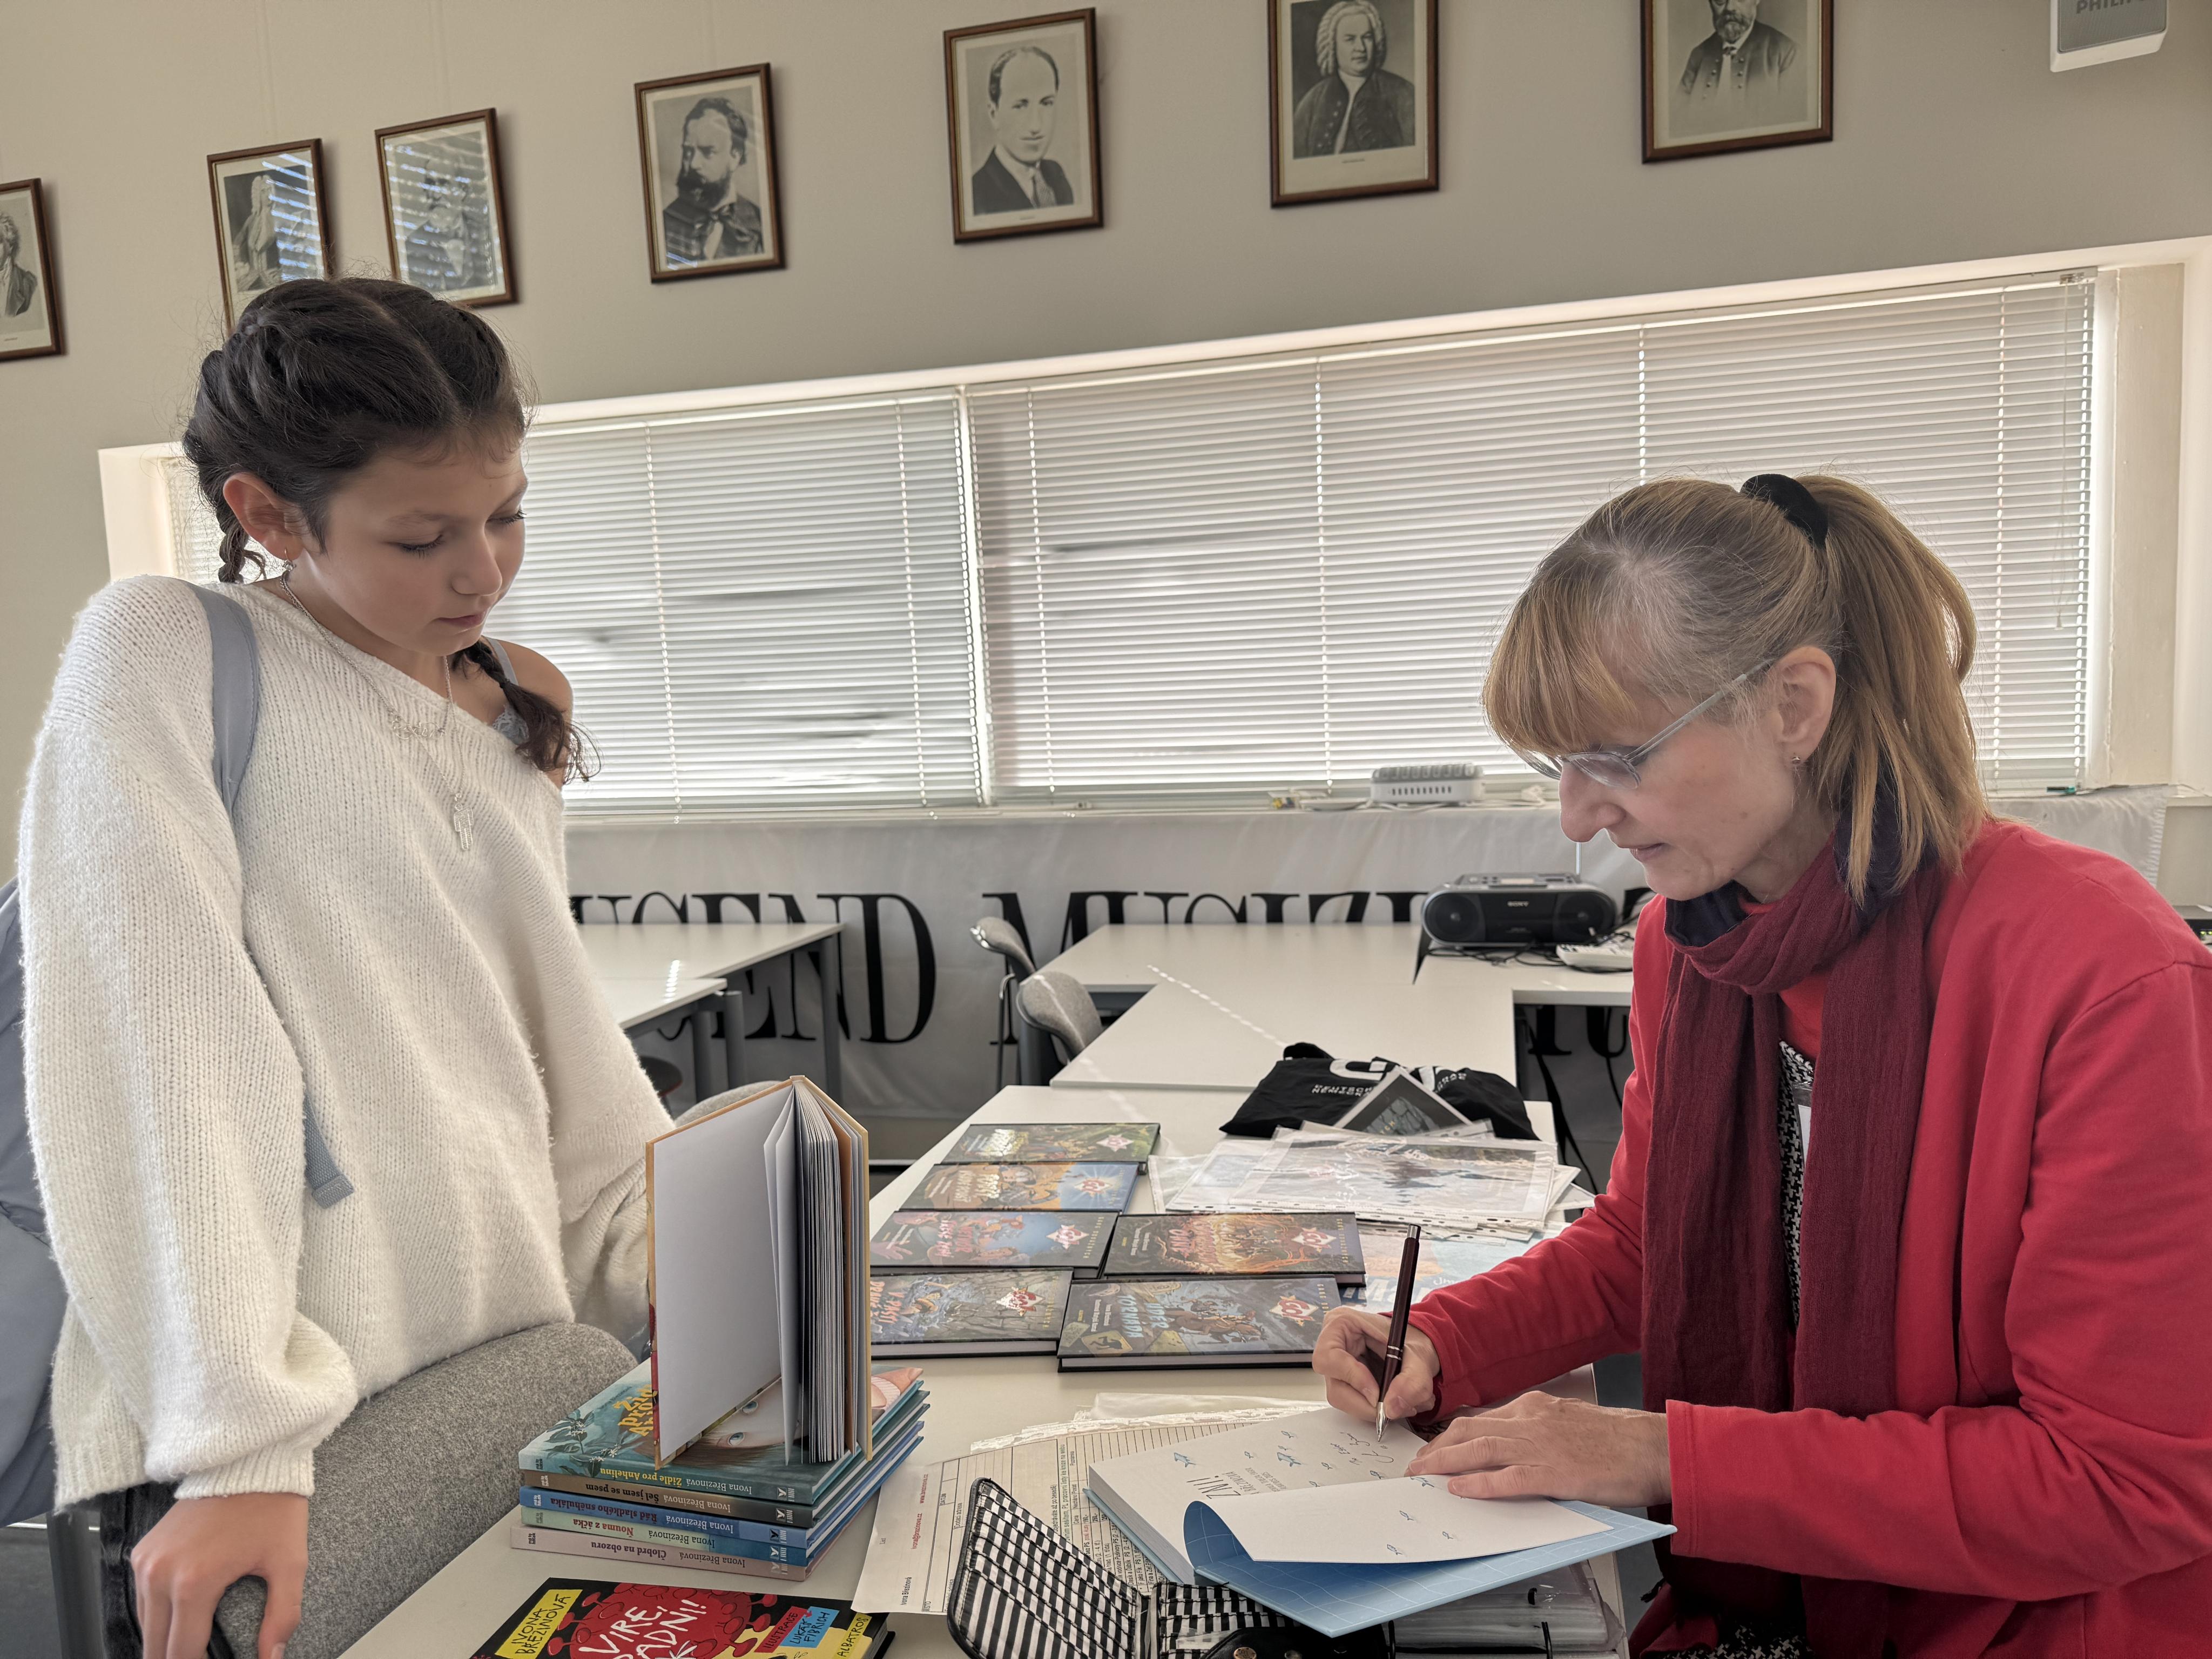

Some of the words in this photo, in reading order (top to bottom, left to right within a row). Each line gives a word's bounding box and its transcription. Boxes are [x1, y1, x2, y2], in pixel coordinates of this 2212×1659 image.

[600, 1468, 640, 1481] Anhelinu
[642, 1473, 658, 1481] pro
[659, 1474, 682, 1487] Židle
[585, 1483, 609, 1493] psem
[686, 1479, 726, 1492] Březinová
[729, 1483, 752, 1495] Ivona
[623, 1488, 644, 1498] jsem
[645, 1493, 659, 1504] Šel
[550, 1498, 596, 1510] sněhuláka
[663, 1495, 705, 1509] Březinová
[707, 1501, 731, 1513] Ivona
[598, 1506, 637, 1519] sladkého
[639, 1512, 657, 1524] Řád
[573, 1519, 593, 1530] áčka
[666, 1515, 707, 1530] Březinová
[710, 1522, 733, 1534] Ivona
[602, 1525, 633, 1537] Ňouma
[649, 1530, 689, 1545] Březinová
[692, 1536, 715, 1548] Ivona
[591, 1542, 622, 1551] obzoru
[638, 1547, 666, 1560] Člobrd
[679, 1552, 720, 1564] Březinová
[722, 1557, 745, 1568] Ivona
[902, 1577, 912, 1595] Březinová
[511, 1607, 546, 1645] IVONA
[515, 1593, 571, 1655] BŘEZINOVÁ
[764, 1612, 798, 1648] ILUSTRACE
[804, 1611, 831, 1643] FIBRICH
[789, 1617, 812, 1645] LUKÁŠ
[837, 1616, 869, 1658] ALBATROS
